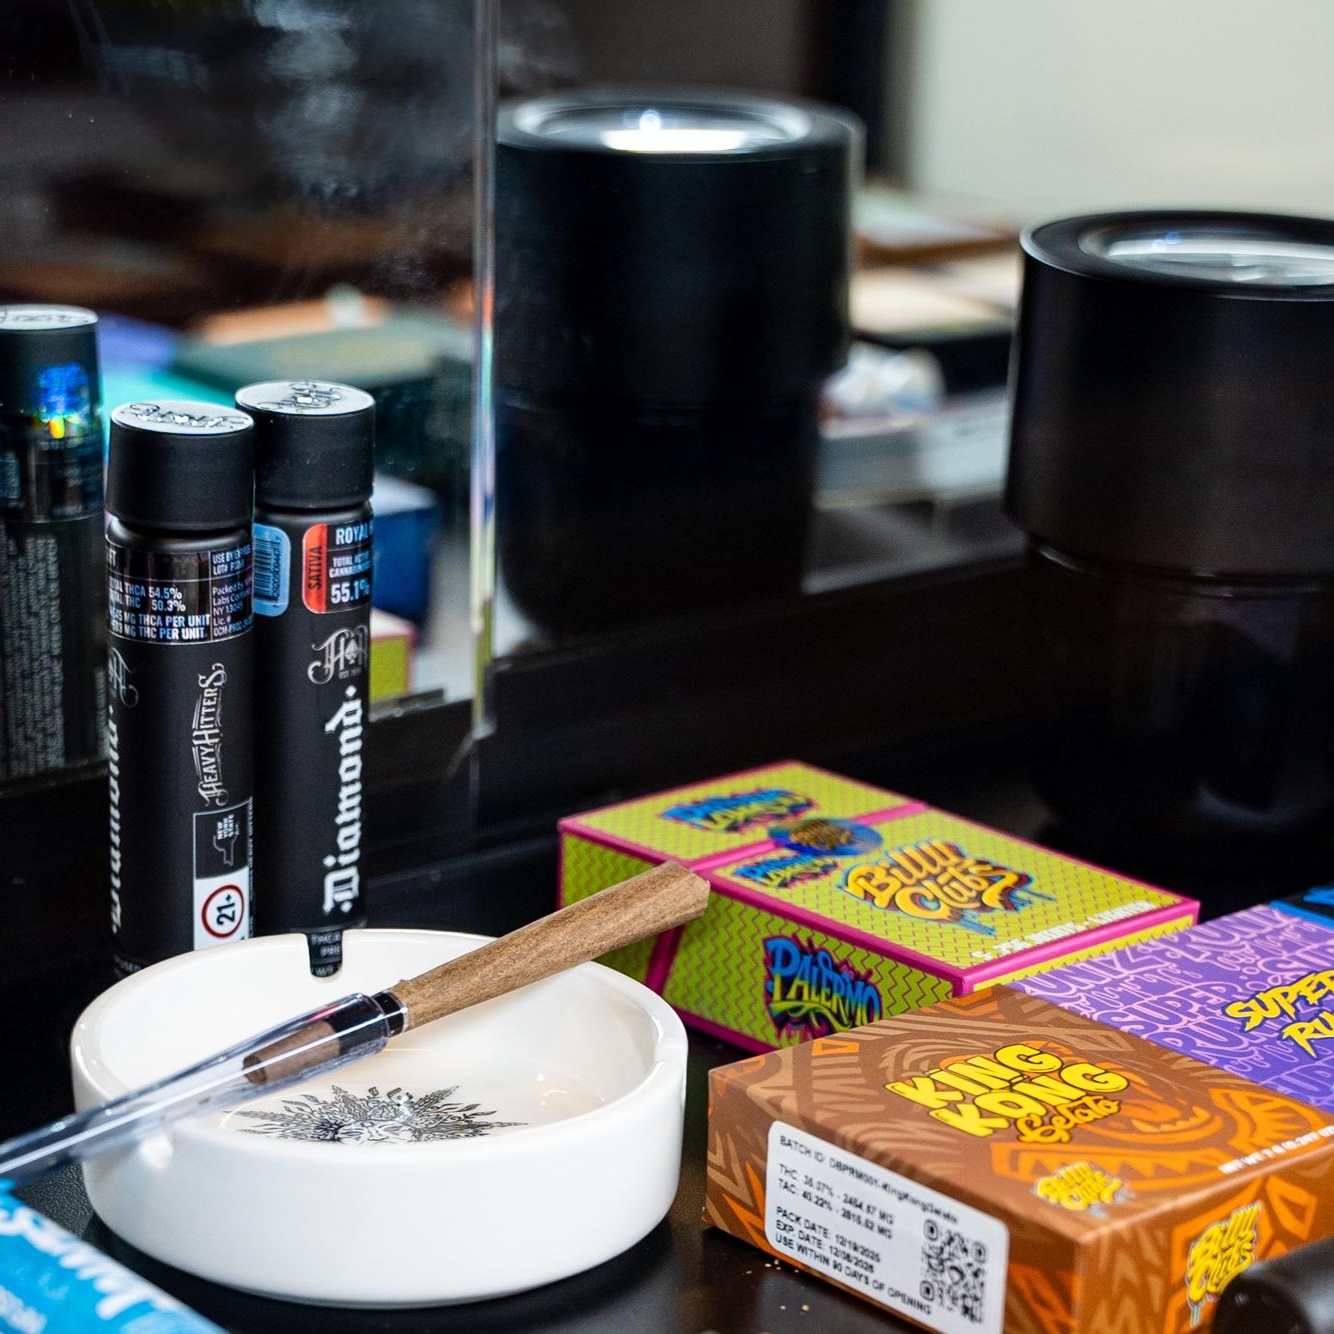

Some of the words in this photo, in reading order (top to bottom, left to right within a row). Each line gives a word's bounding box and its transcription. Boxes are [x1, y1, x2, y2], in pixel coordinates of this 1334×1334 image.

[308, 546, 323, 590] SATIVA
[330, 578, 370, 604] 55.1%
[323, 698, 363, 917] Diamond
[846, 838, 962, 902] Billy
[895, 862, 1023, 921] Clubs
[217, 894, 235, 925] 21+
[765, 937, 881, 1033] PALERMO
[884, 1043, 1063, 1109] KING
[929, 1062, 1129, 1137] KONG
[1015, 1095, 1121, 1143] Gelato
[780, 1135, 811, 1159] BATCH
[776, 1205, 802, 1226] PACK
[804, 1219, 830, 1240] DATE:
[877, 1224, 893, 1240] MG
[879, 1209, 895, 1225] MG
[798, 1230, 824, 1252] DATE:
[775, 1233, 795, 1250] USE
[796, 1241, 830, 1266] WITHIN
[845, 1263, 870, 1287] DAYS
[871, 1278, 885, 1292] OF
[886, 1285, 932, 1316] OPENING
